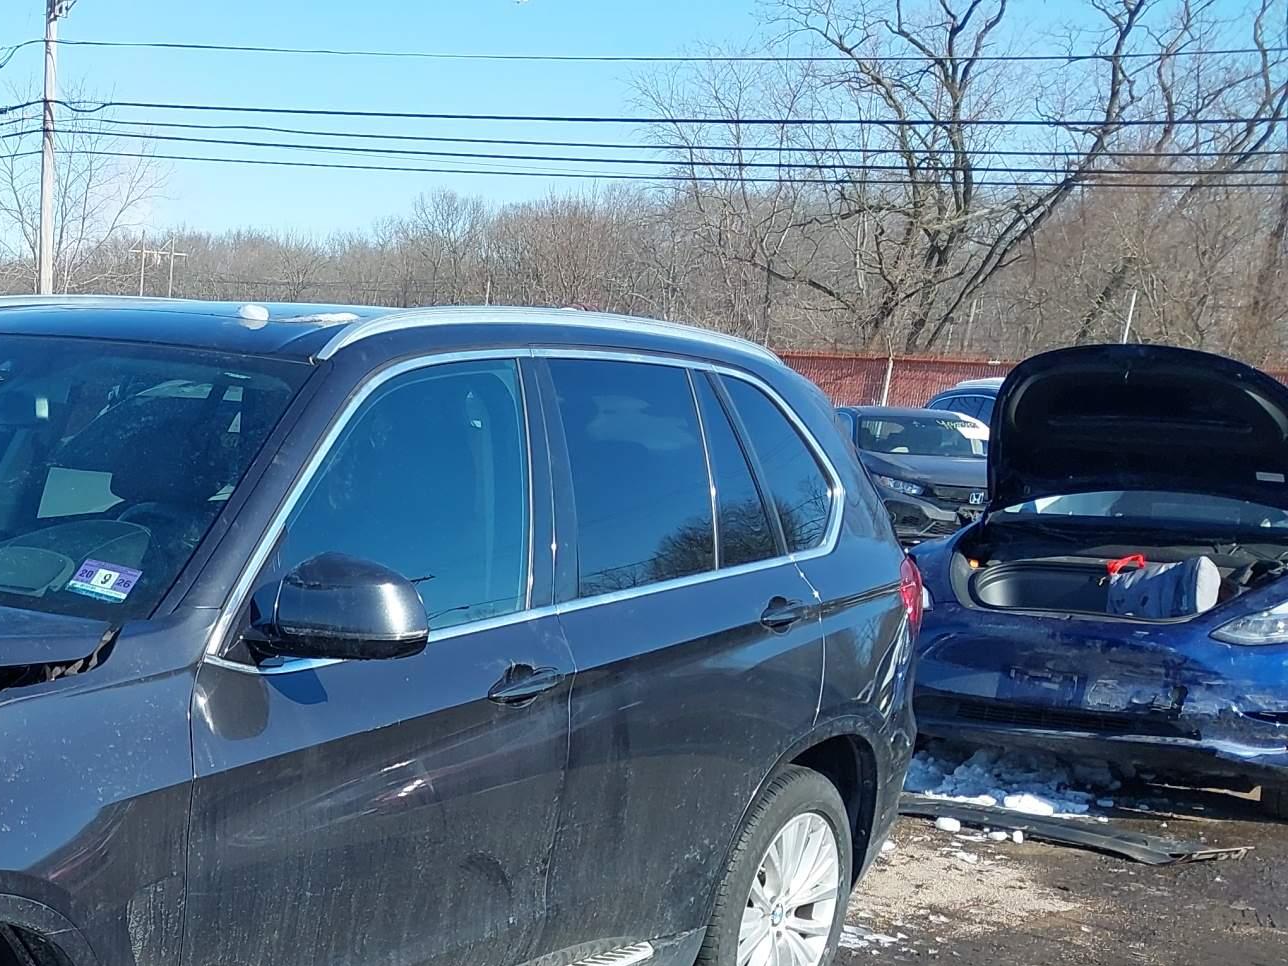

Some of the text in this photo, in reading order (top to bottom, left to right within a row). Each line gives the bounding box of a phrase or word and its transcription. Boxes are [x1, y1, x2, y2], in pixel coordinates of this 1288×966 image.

[79, 568, 133, 588] 20 9 26
